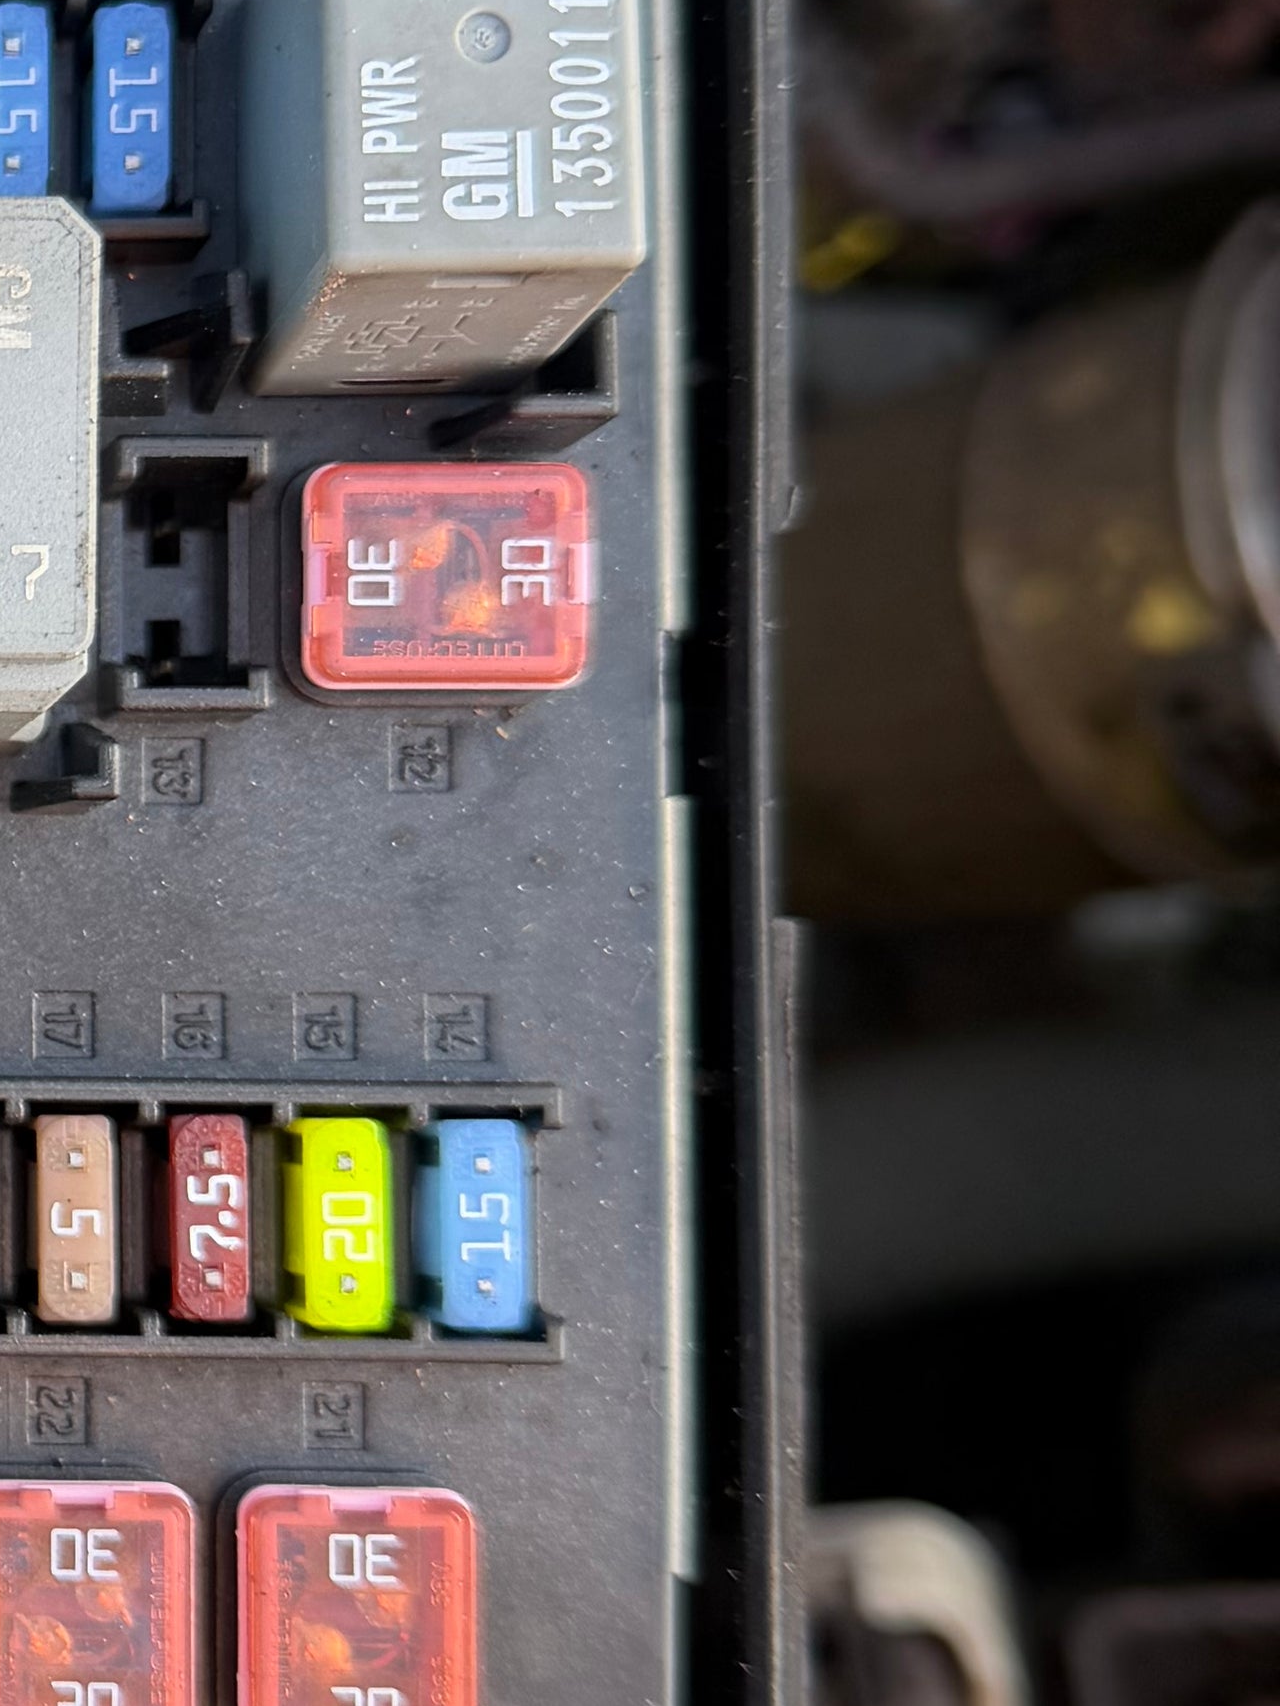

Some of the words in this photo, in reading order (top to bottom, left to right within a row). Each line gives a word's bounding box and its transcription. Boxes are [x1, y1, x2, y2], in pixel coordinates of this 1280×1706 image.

[109, 67, 158, 136] 15
[364, 56, 420, 158] PWR
[364, 173, 420, 224] HI
[444, 130, 510, 221] GM
[348, 539, 398, 606] 30
[502, 539, 553, 604] 30
[51, 1201, 100, 1237] 5
[187, 1173, 241, 1262] 7.5
[322, 1191, 375, 1262] 20
[460, 1193, 511, 1264] 15
[51, 1529, 120, 1578] 30
[329, 1535, 399, 1583] 30
